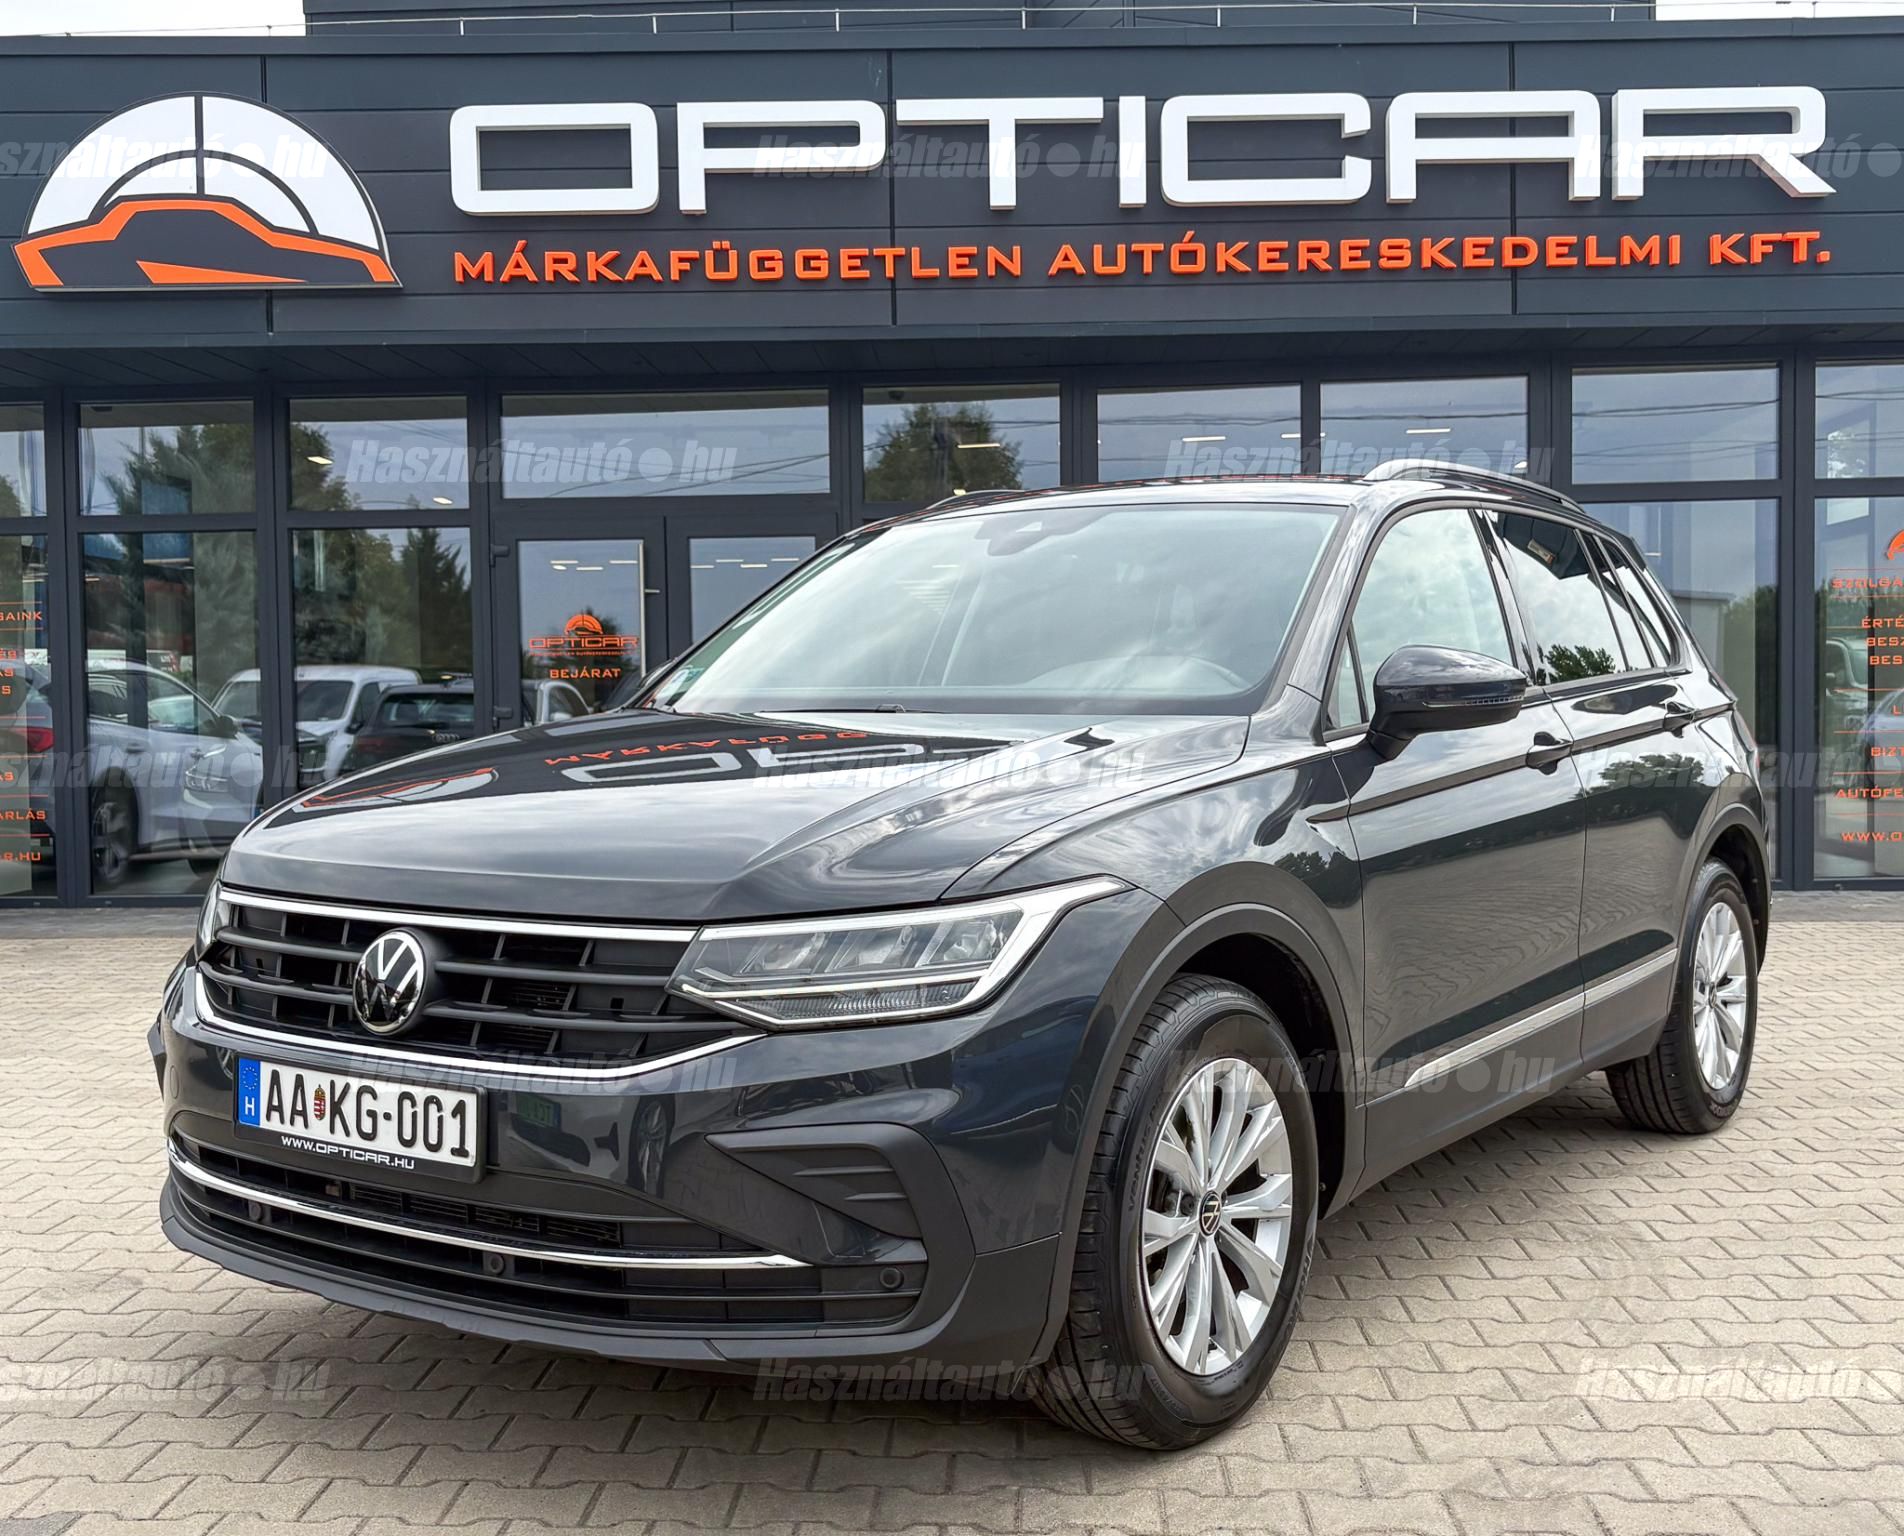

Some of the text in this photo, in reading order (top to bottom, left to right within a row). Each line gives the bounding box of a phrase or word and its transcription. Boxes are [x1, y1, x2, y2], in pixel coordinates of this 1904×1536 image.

[450, 86, 1837, 216] OPTICAR
[453, 230, 1831, 284] MÁRKAFÜGGETLEN AUTÓKERESKEDELMI KFT.
[529, 636, 638, 649] OPTICAR
[549, 666, 621, 679] BEJÁRAT
[244, 1096, 255, 1116] H
[281, 1135, 415, 1170] WWW.OPTICAR.HU
